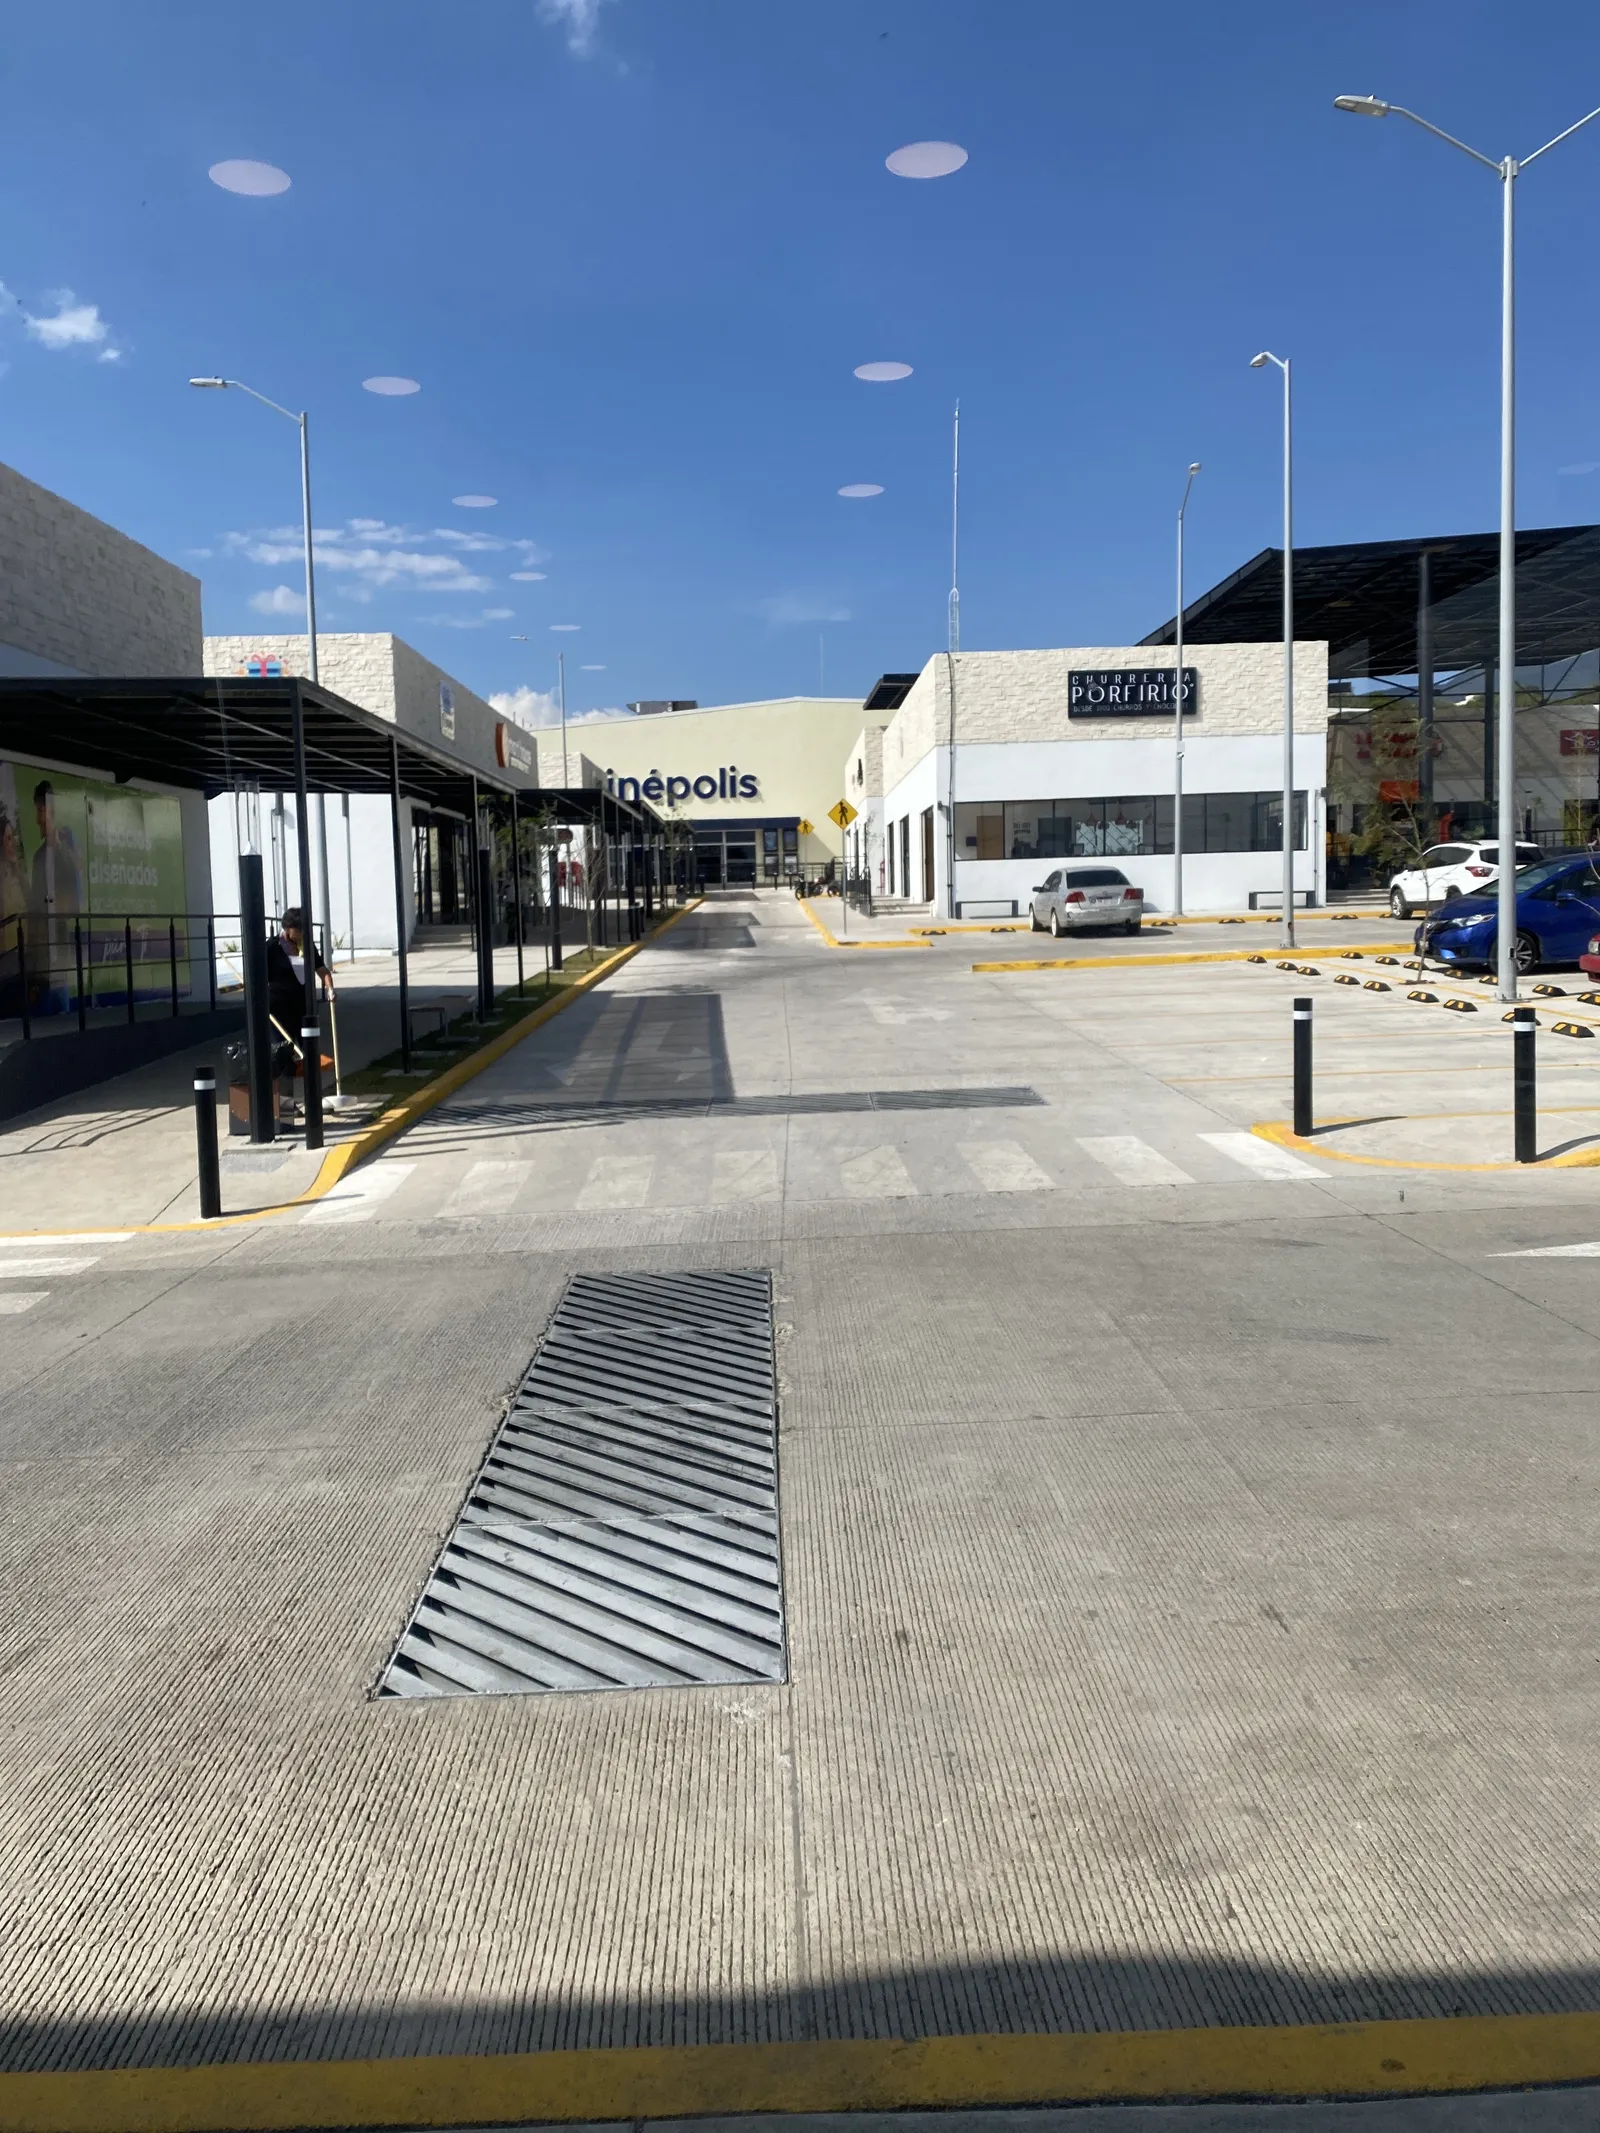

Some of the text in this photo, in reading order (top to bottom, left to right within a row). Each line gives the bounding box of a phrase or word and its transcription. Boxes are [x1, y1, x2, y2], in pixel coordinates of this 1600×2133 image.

[1072, 683, 1189, 704] PORFIRIO
[1113, 703, 1143, 711] CHURROS
[607, 765, 759, 807] inépolis
[89, 856, 158, 887] diseñados
